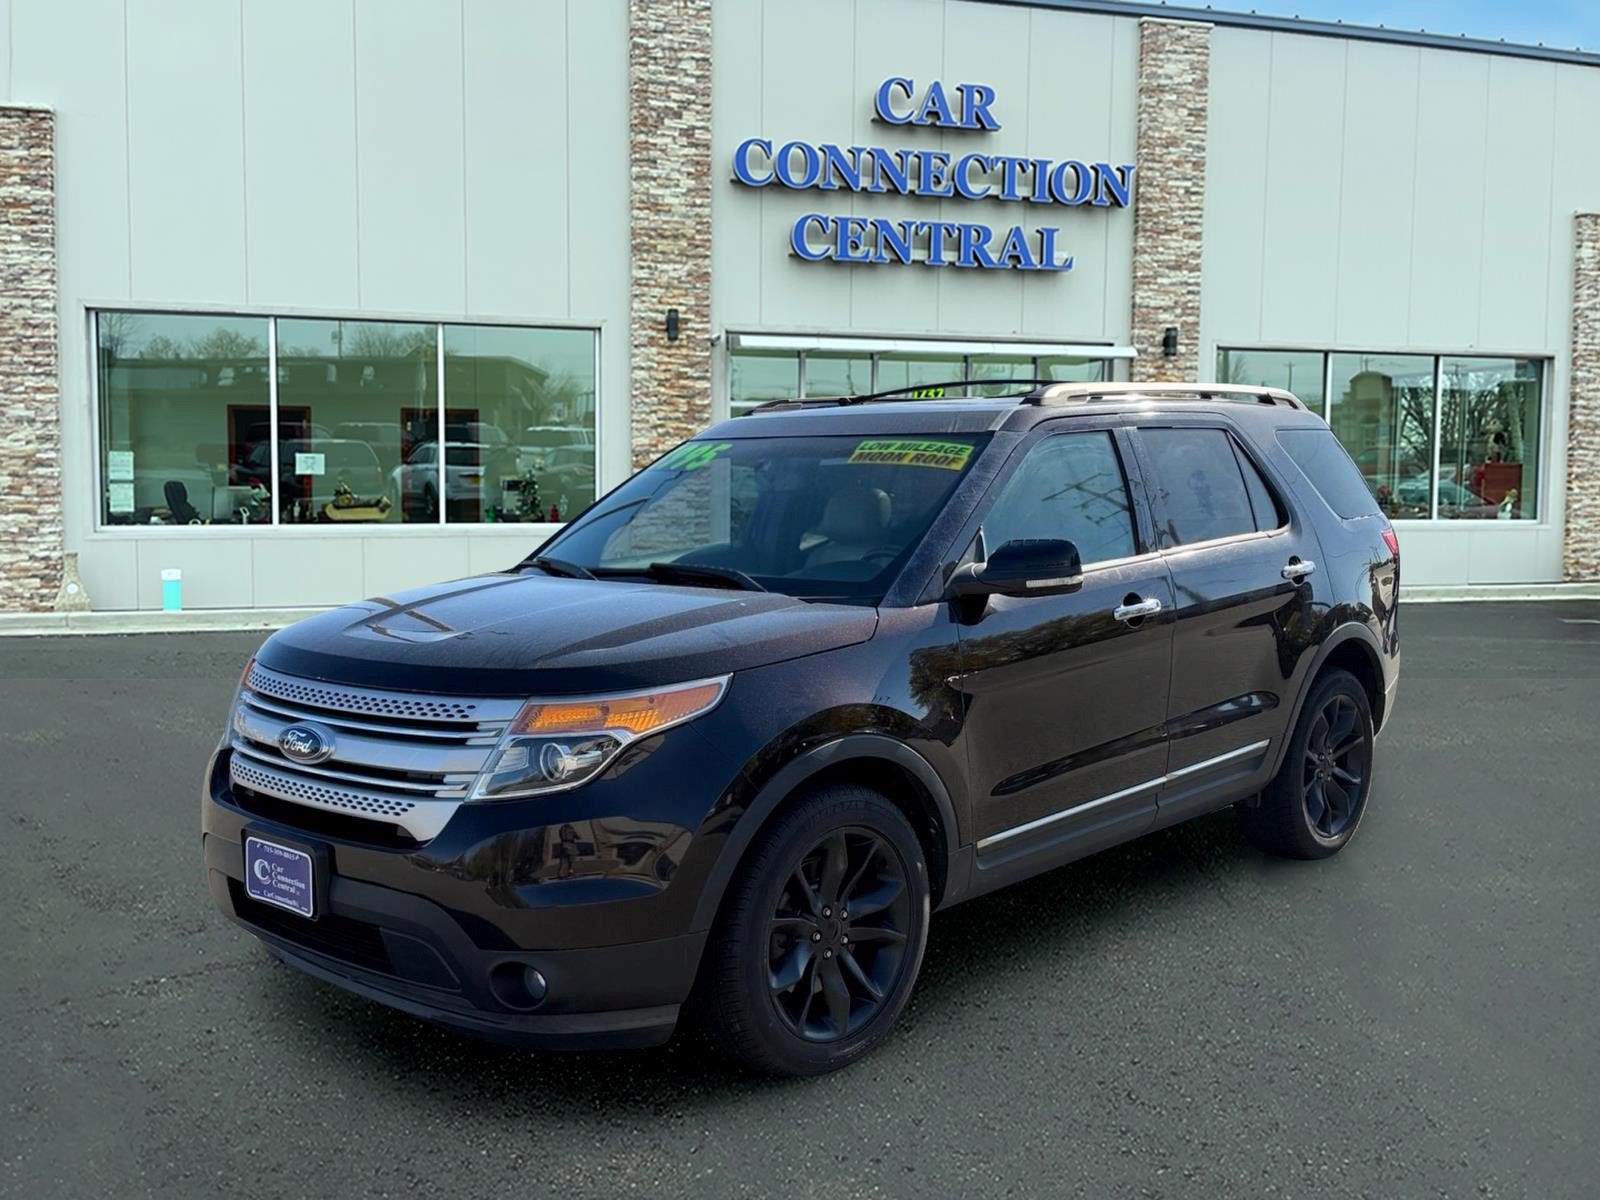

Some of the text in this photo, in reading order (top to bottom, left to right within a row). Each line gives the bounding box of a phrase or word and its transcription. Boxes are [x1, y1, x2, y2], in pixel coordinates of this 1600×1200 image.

[873, 76, 1001, 131] CAR
[732, 137, 1135, 208] CONNECTION
[789, 213, 1075, 272] CENTRAL
[859, 441, 970, 456] LOW MILEAGE
[852, 451, 963, 467] MOON ROOF
[283, 729, 313, 753] Ford
[272, 863, 284, 873] Car
[272, 871, 305, 888] Connection
[272, 879, 296, 893] Central
